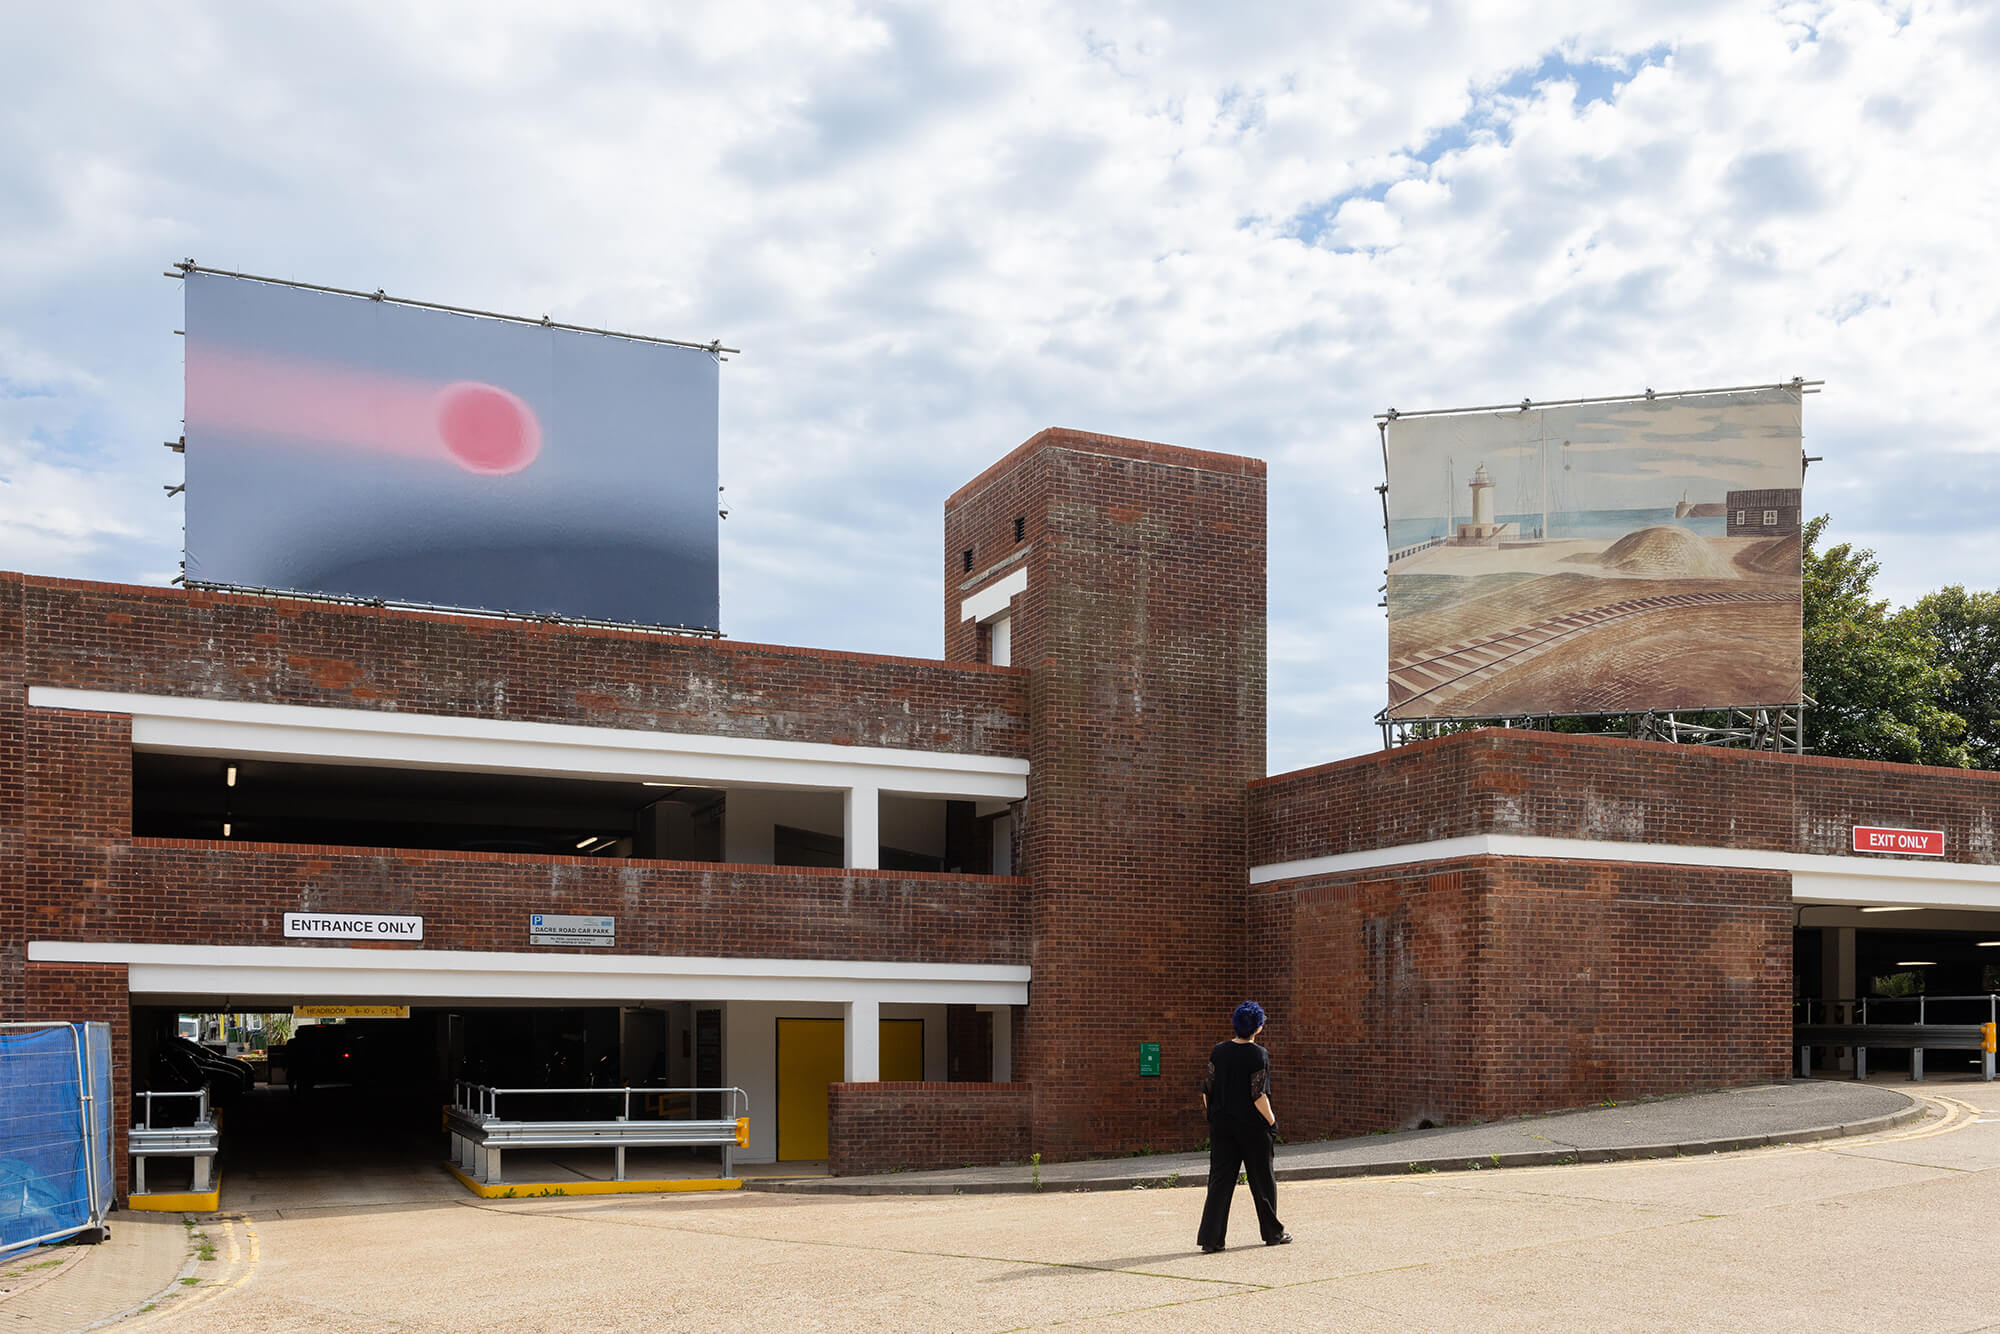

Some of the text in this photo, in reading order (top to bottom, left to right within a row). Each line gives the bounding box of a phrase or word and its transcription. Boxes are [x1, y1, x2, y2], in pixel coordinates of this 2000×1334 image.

[1869, 833, 1929, 849] EXIT ONLY
[291, 919, 416, 934] ENTRANCE ONLY
[534, 916, 542, 926] P
